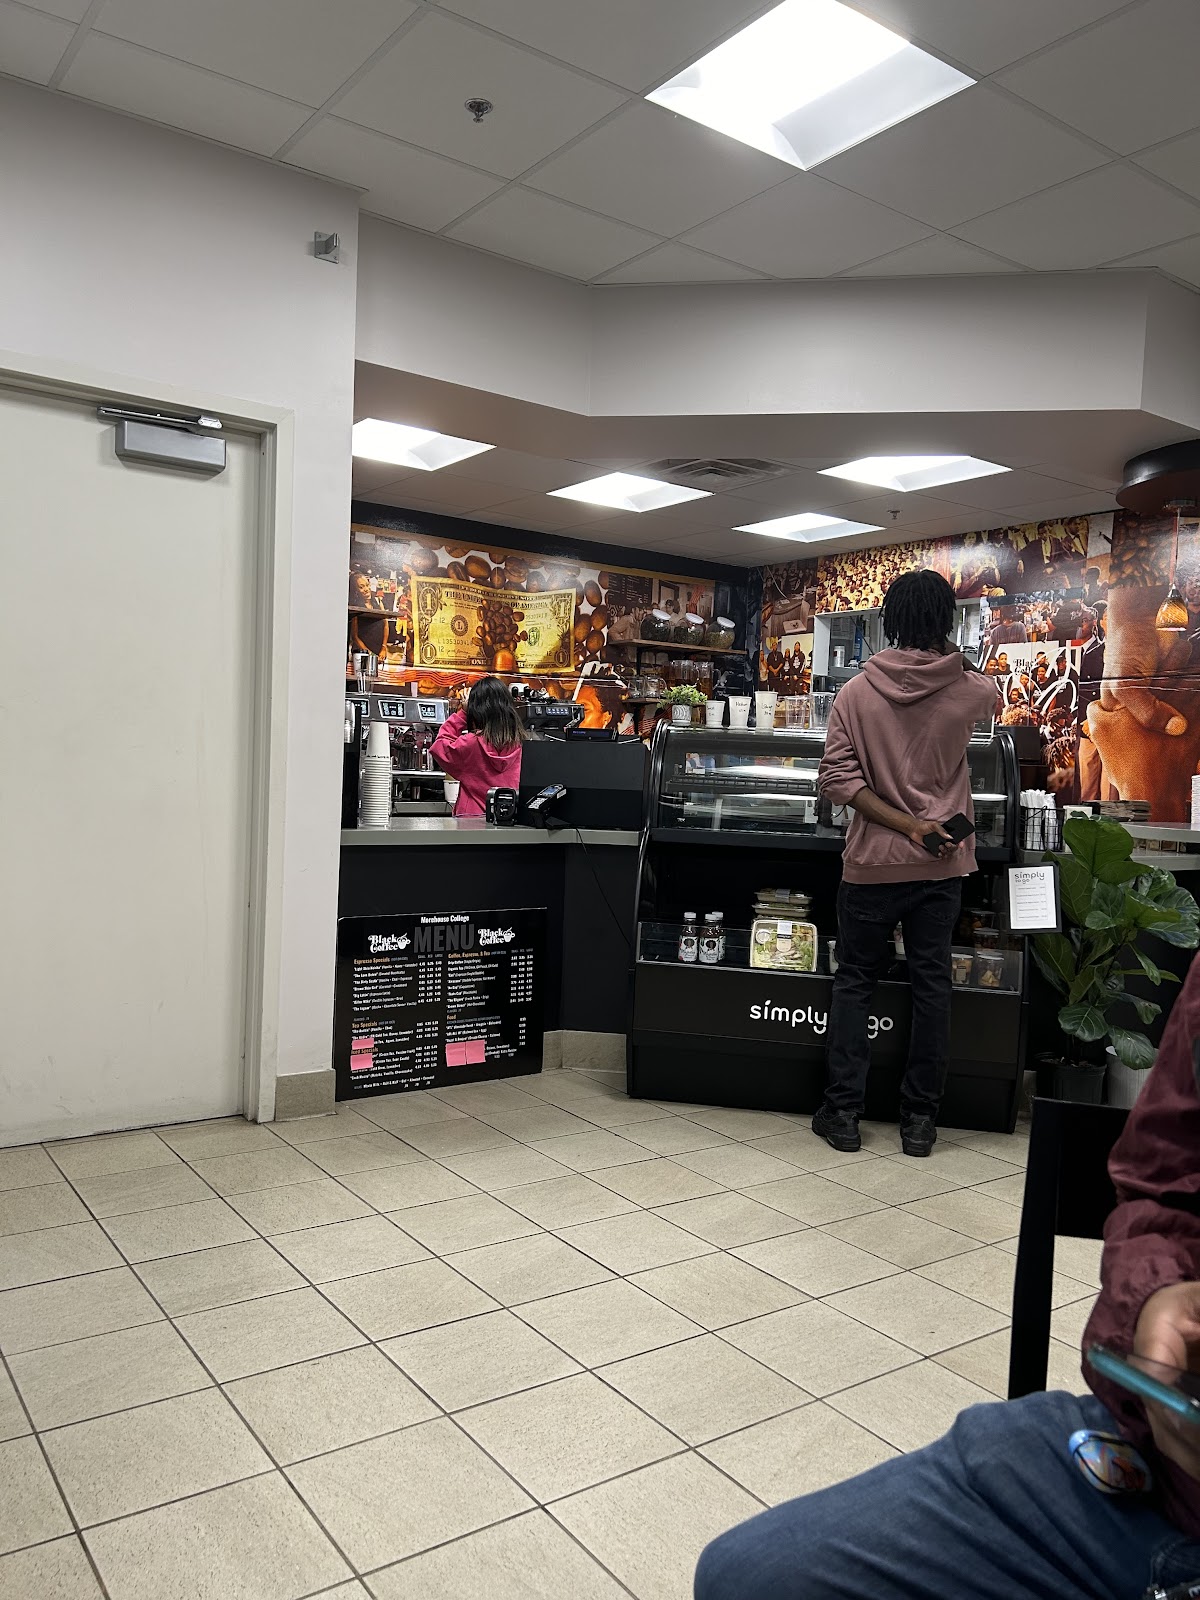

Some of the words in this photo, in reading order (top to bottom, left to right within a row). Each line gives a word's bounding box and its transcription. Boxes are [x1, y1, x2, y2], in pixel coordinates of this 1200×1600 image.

[1014, 871, 1045, 881] simply
[420, 916, 449, 924] Morehouse
[450, 914, 470, 923] College
[477, 927, 505, 937] Black
[368, 933, 397, 944] Black
[413, 923, 475, 954] MENU
[479, 935, 504, 946] Coffee
[369, 941, 398, 954] Coffee
[373, 956, 390, 964] Specials
[749, 999, 828, 1035] simply
[867, 1015, 894, 1039] go
